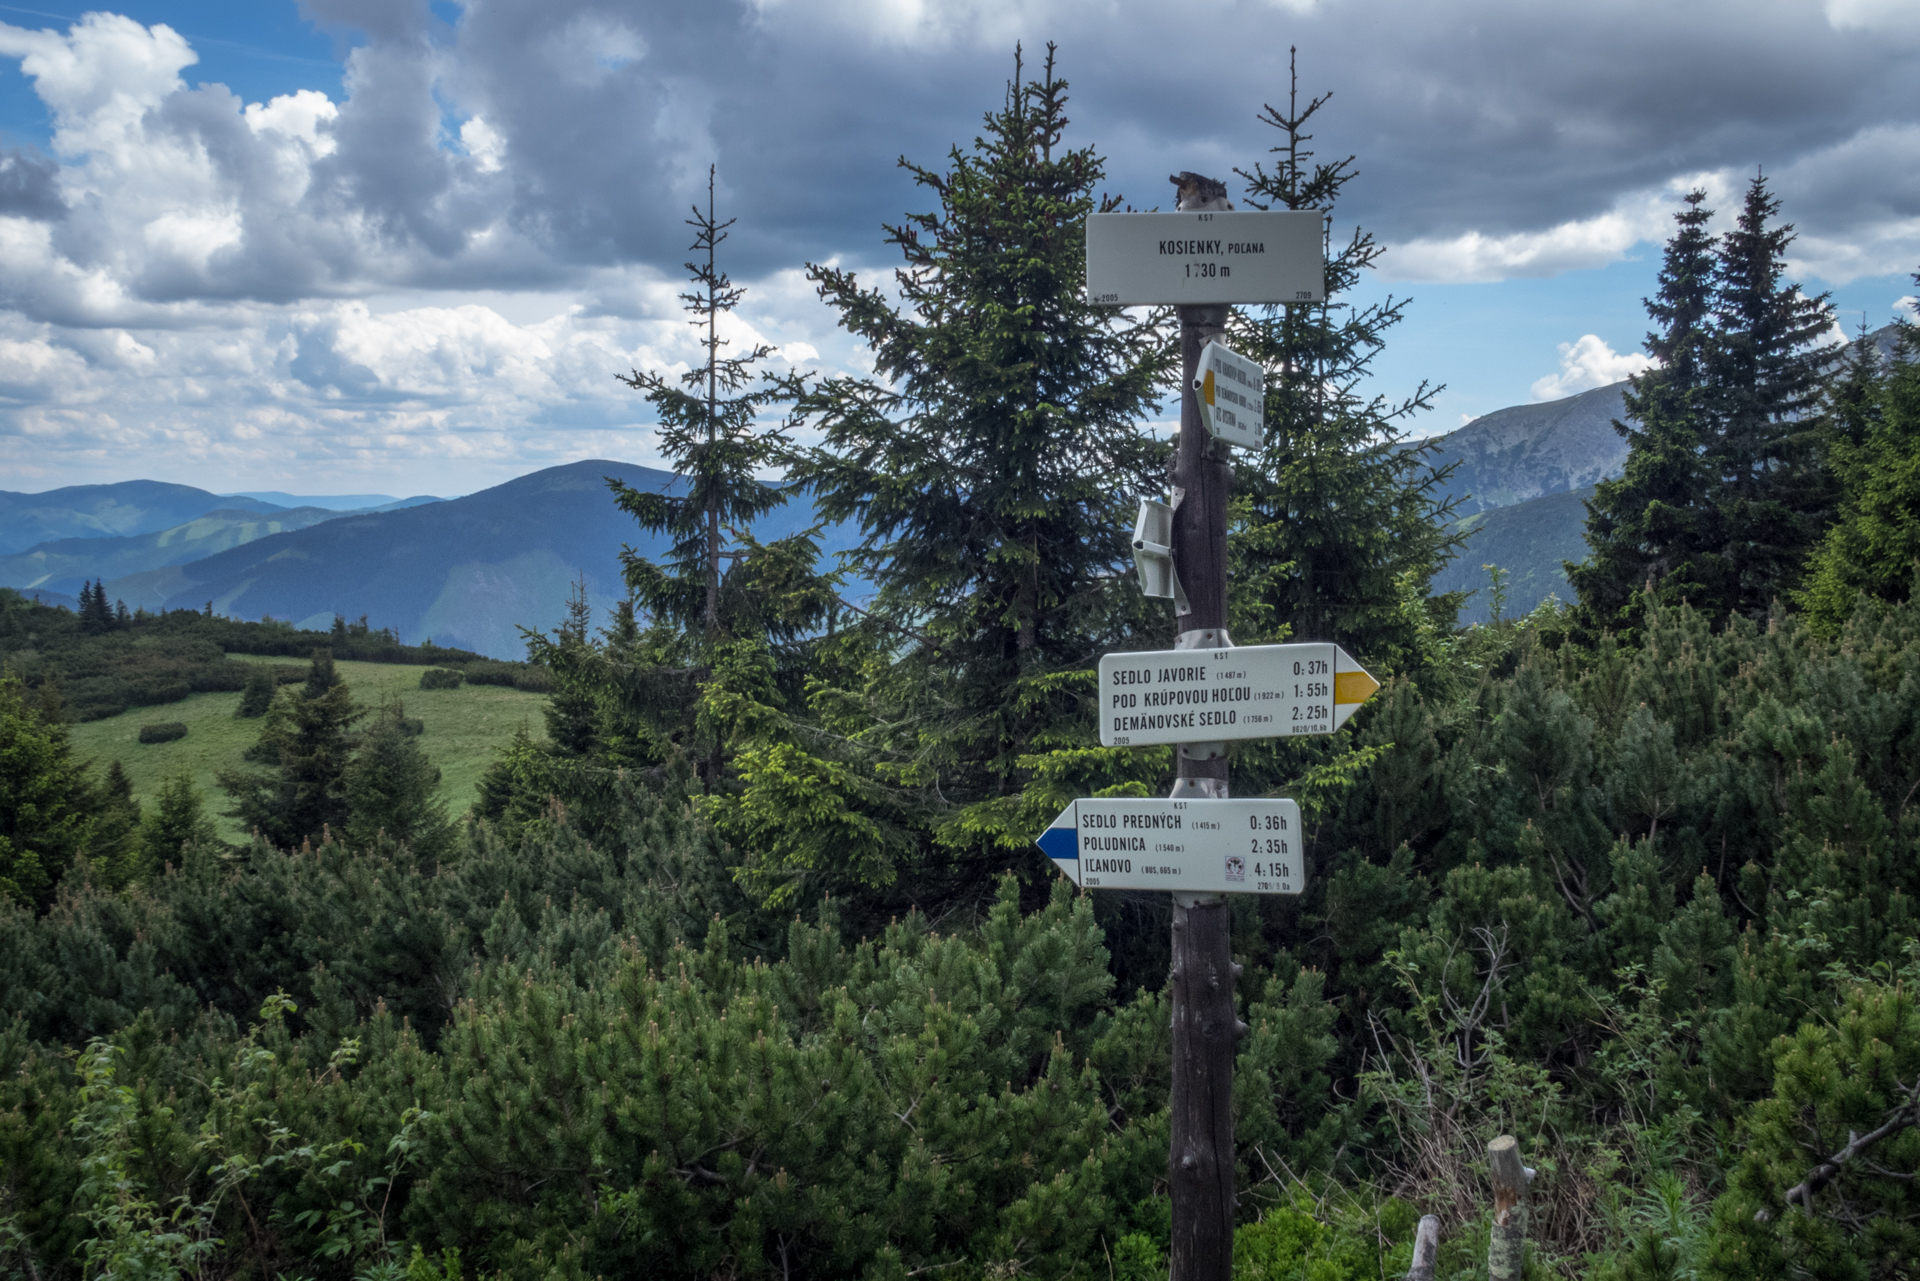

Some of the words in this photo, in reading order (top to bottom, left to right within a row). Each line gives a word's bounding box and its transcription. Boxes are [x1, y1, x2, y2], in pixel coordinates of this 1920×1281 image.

[1159, 240, 1225, 256] KOSIENKY,
[1101, 294, 1118, 302] 2005
[1296, 292, 1312, 300] 2709
[1214, 652, 1228, 660] KST
[1113, 670, 1151, 685] SEDLO
[1158, 667, 1206, 682] JAVORIE
[1113, 694, 1136, 708] POD
[1144, 689, 1208, 706] KRÚPOVOU
[1212, 687, 1250, 702] HOĽOU
[1114, 710, 1194, 731] DEMÄNOVSKÉ
[1199, 710, 1236, 726] SEDLO
[1083, 814, 1116, 828] SEDLO
[1123, 812, 1181, 829] PREDNÝCH
[1084, 837, 1146, 851] POLUDNICA
[1085, 859, 1131, 873] IĽANOVO
